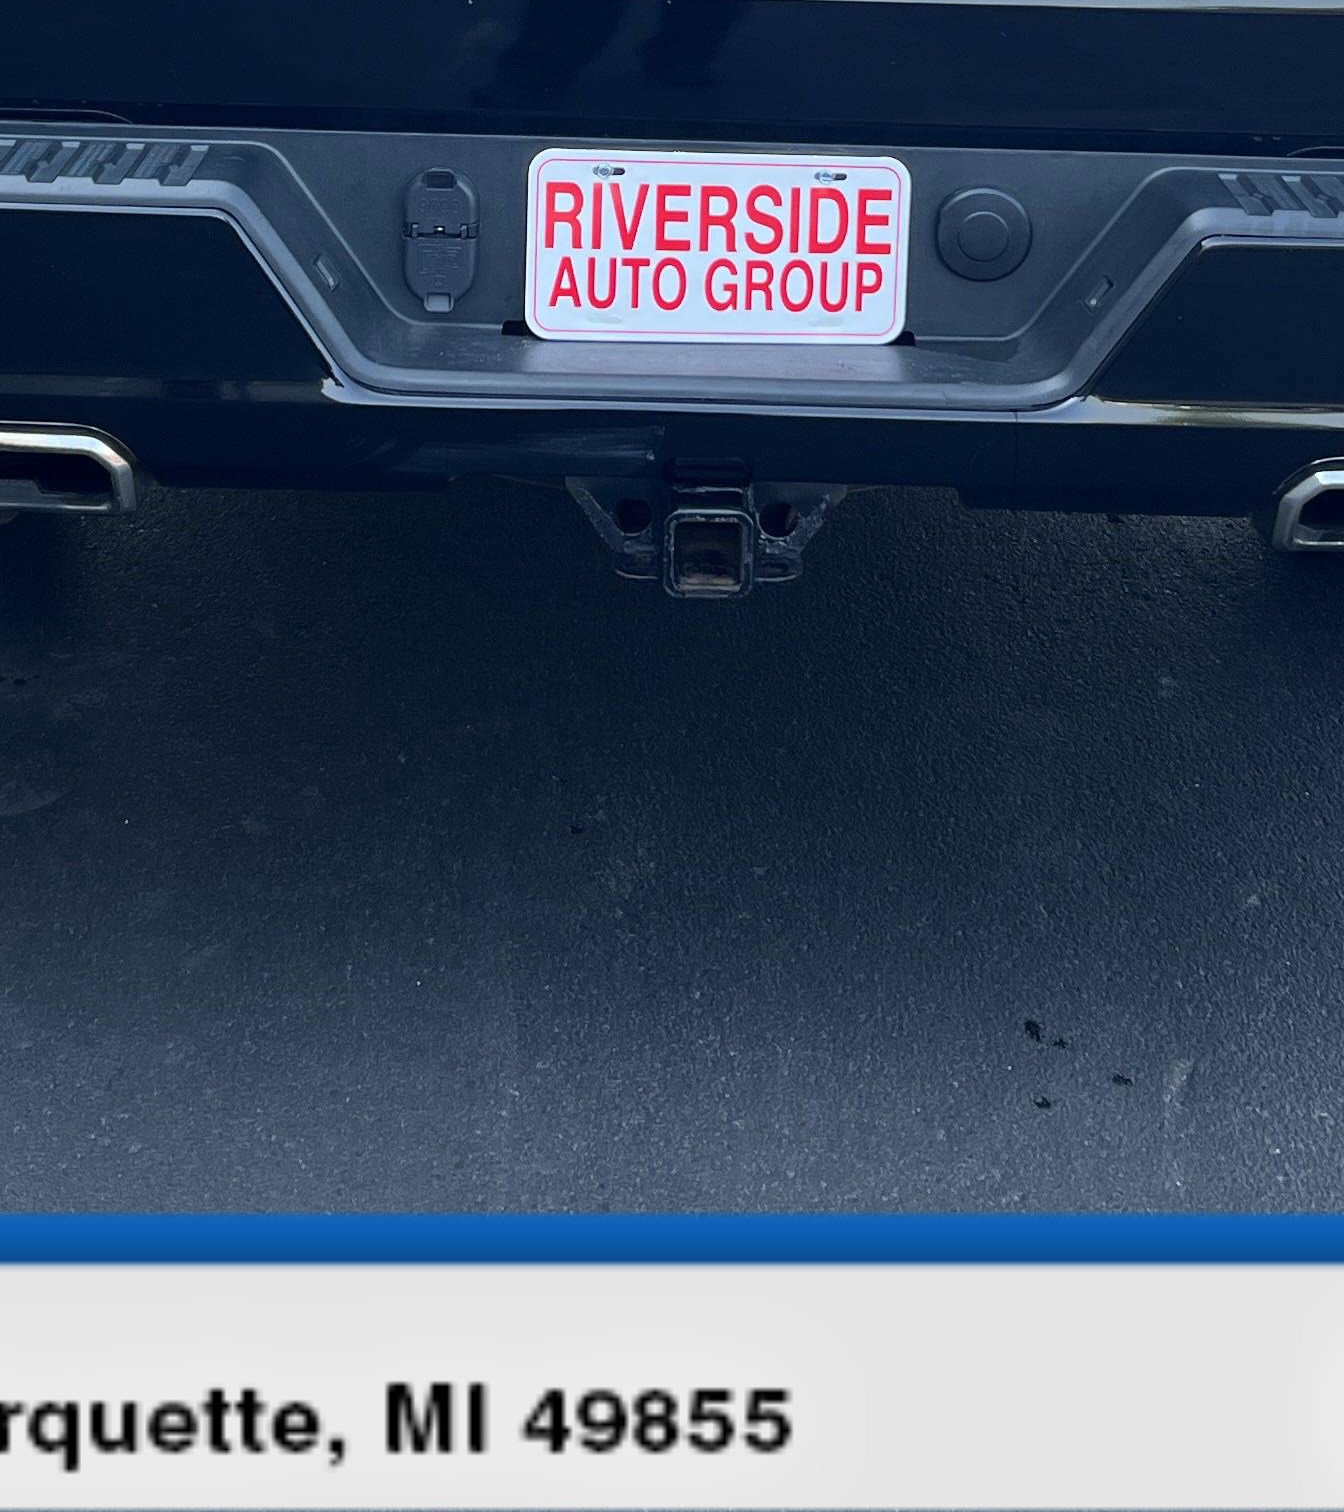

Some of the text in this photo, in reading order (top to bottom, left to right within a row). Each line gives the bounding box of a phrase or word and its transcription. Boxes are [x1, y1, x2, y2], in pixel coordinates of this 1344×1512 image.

[543, 180, 893, 256] RIVERSIDE
[548, 256, 885, 313] AUTO GROUP
